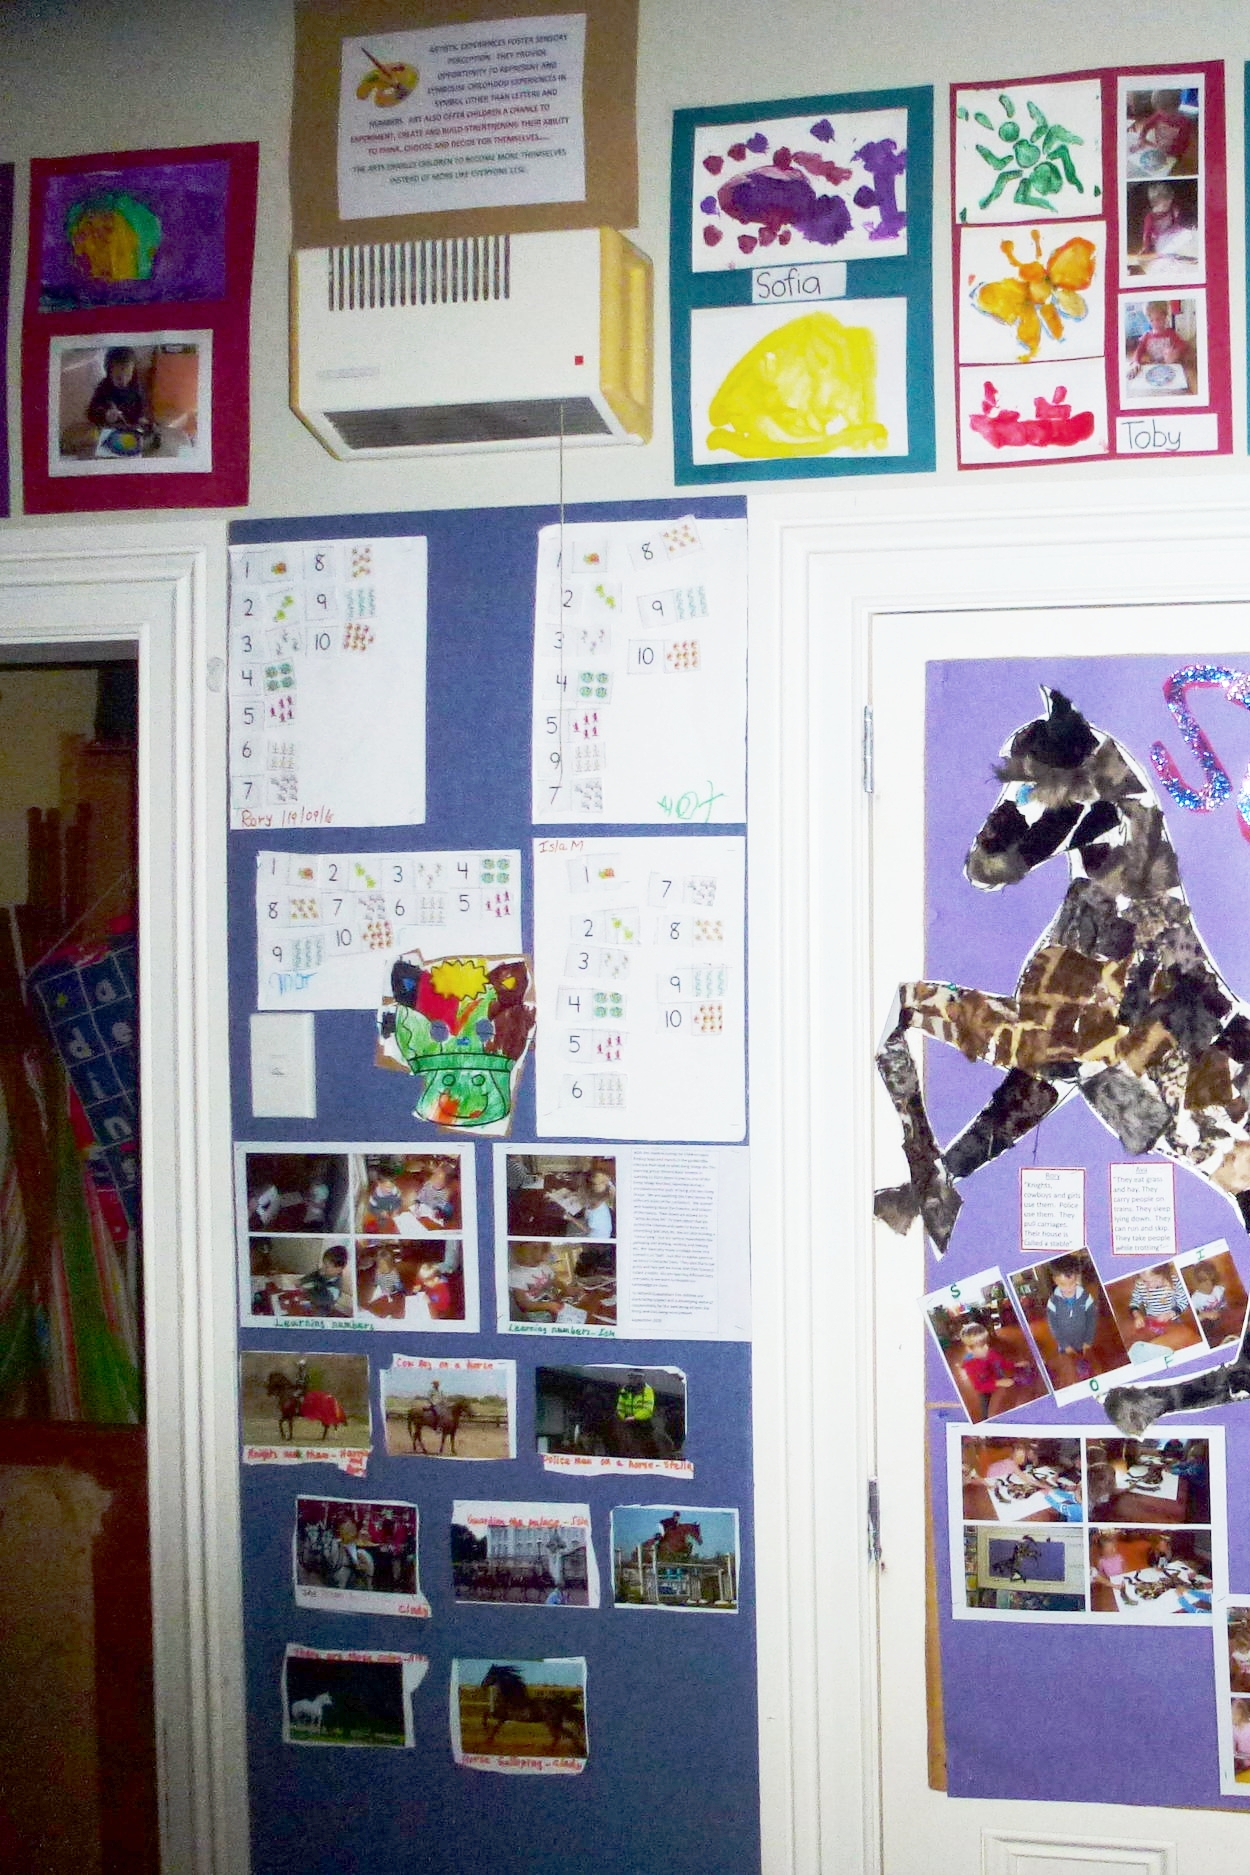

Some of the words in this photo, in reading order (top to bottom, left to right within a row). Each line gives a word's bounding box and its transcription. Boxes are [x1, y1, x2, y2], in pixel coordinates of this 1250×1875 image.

[754, 267, 823, 302] Sofia
[1120, 420, 1184, 455] Toby
[642, 542, 653, 560] 8
[315, 554, 325, 571] 8
[317, 594, 326, 609] 9
[561, 588, 572, 607] 2
[244, 599, 253, 616] 2
[652, 600, 663, 616] 9
[242, 635, 252, 652] 3
[316, 633, 330, 650] 10
[554, 632, 564, 649] 3
[639, 647, 654, 664] 10
[242, 670, 253, 686] 4
[557, 675, 567, 692] 4
[244, 707, 254, 725] 5
[547, 717, 557, 734] 5
[242, 744, 251, 758] 6
[244, 782, 252, 799] 7
[549, 786, 562, 804] 7
[538, 839, 568, 853] Isla
[570, 839, 584, 852] M
[329, 864, 337, 881] 2
[394, 866, 402, 882] 3
[458, 863, 468, 879] 4
[662, 880, 671, 897] 7
[268, 902, 278, 919] 8
[333, 899, 342, 915] 7
[395, 900, 405, 916] 6
[459, 895, 469, 911] 5
[584, 919, 593, 937] 2
[670, 922, 680, 939] 8
[336, 929, 352, 946] 10
[272, 946, 282, 962] 9
[579, 952, 589, 969] 3
[670, 976, 680, 992] 9
[569, 996, 580, 1012] 4
[666, 1010, 681, 1027] 10
[570, 1036, 580, 1053] 5
[572, 1081, 582, 1098] 6
[949, 1283, 961, 1299] S
